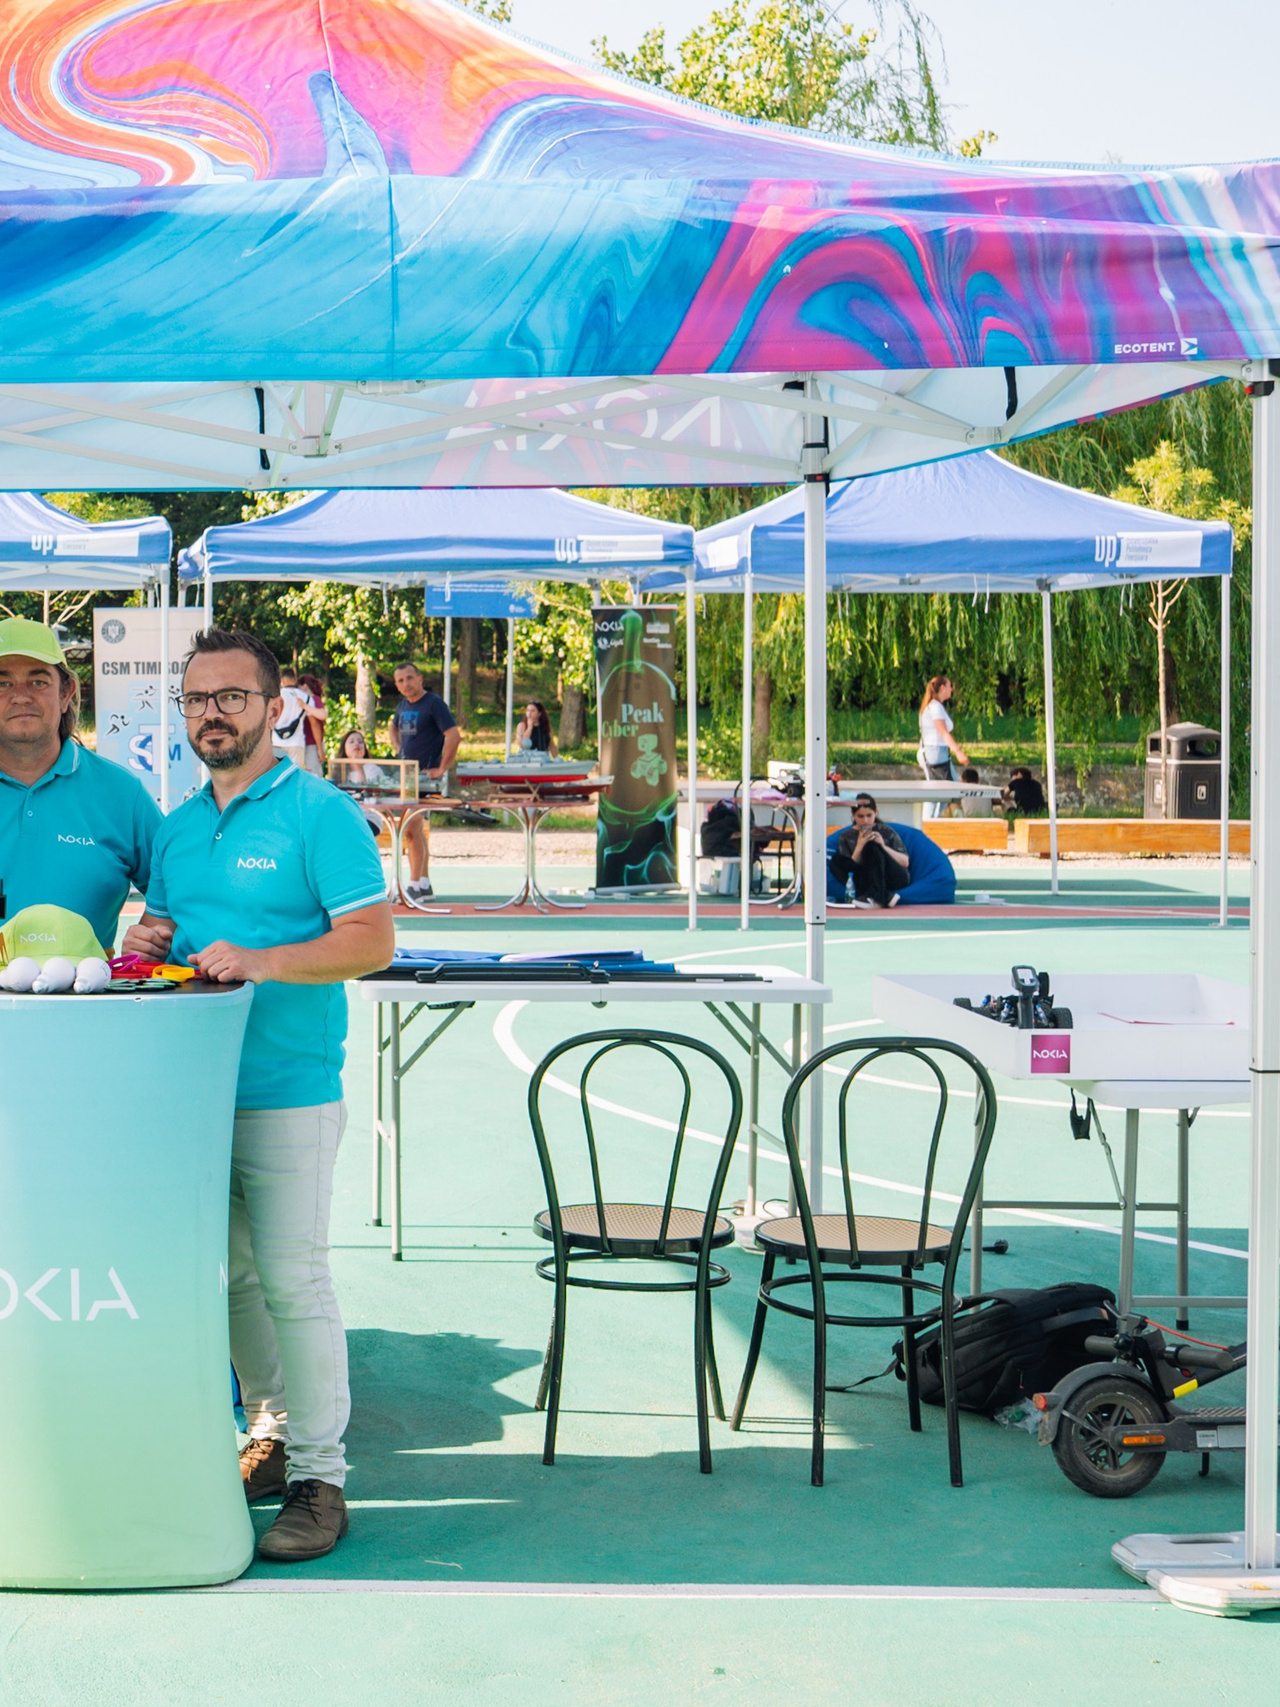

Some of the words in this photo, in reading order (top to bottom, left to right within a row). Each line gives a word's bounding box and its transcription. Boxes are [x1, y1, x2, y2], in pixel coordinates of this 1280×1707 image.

[1114, 342, 1176, 354] ECOTENT
[594, 621, 624, 632] NOKIA
[101, 661, 130, 675] CSM
[621, 702, 664, 724] Peak
[57, 834, 96, 846] NOKIA
[237, 857, 277, 870] NOKIA
[20, 933, 57, 942] NOKIA
[1032, 1049, 1068, 1059] NOKIA
